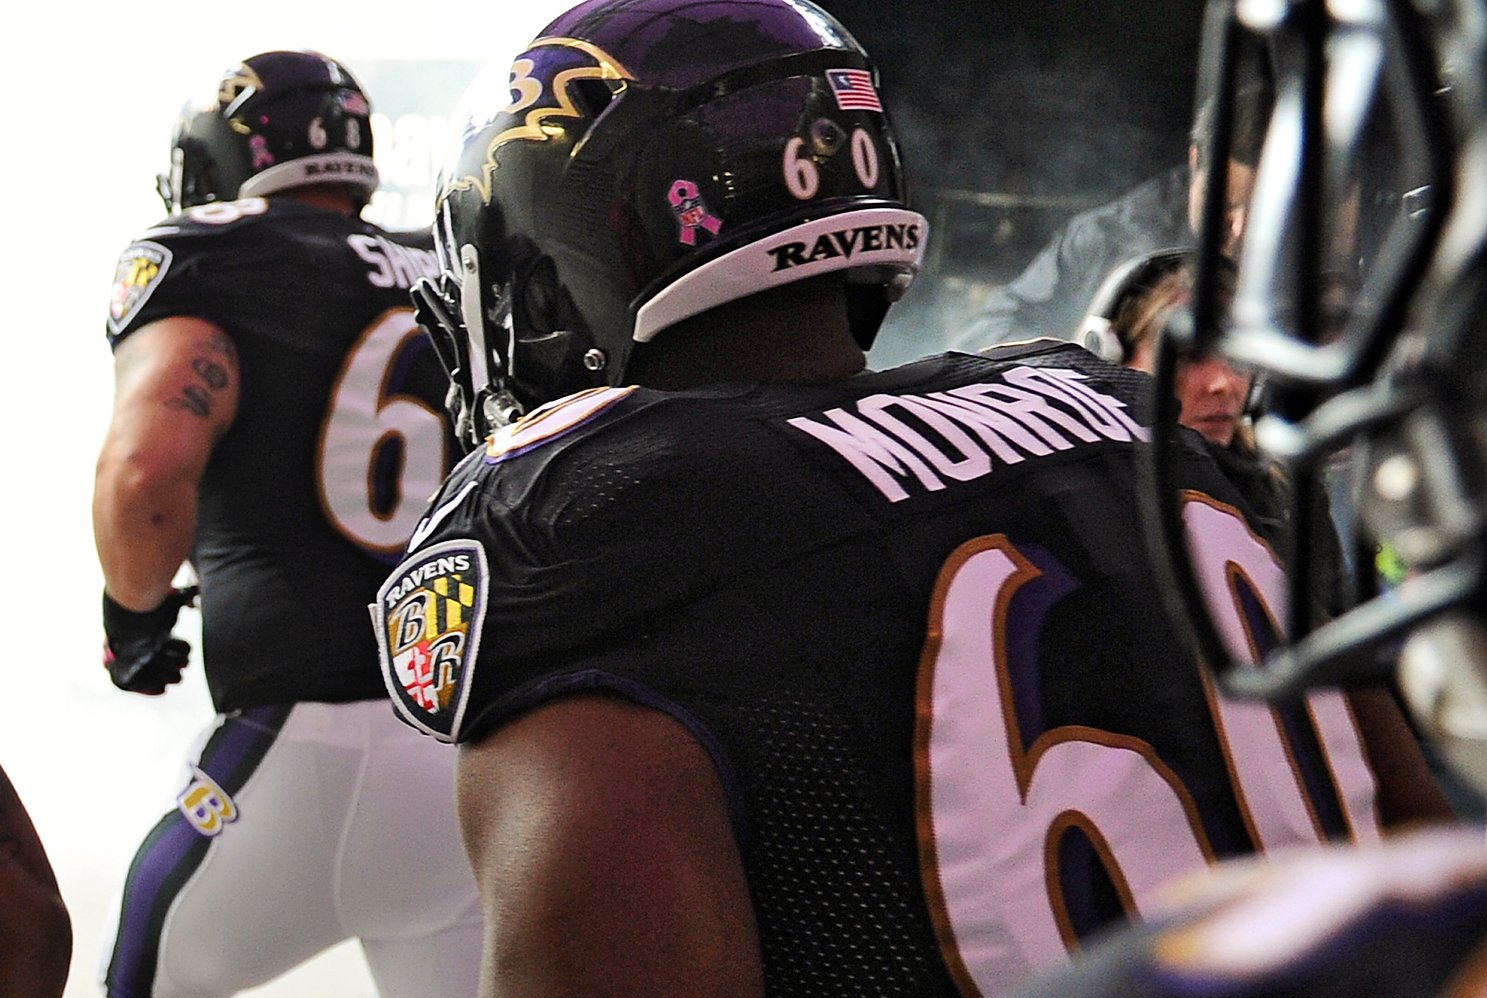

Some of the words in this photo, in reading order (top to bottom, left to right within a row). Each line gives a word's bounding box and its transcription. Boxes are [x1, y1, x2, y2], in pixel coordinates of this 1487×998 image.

[783, 128, 879, 200] 60
[766, 223, 919, 273] RAVENS
[316, 306, 449, 553] 6
[787, 366, 1153, 503] MONROE
[387, 554, 470, 609] RAVENS
